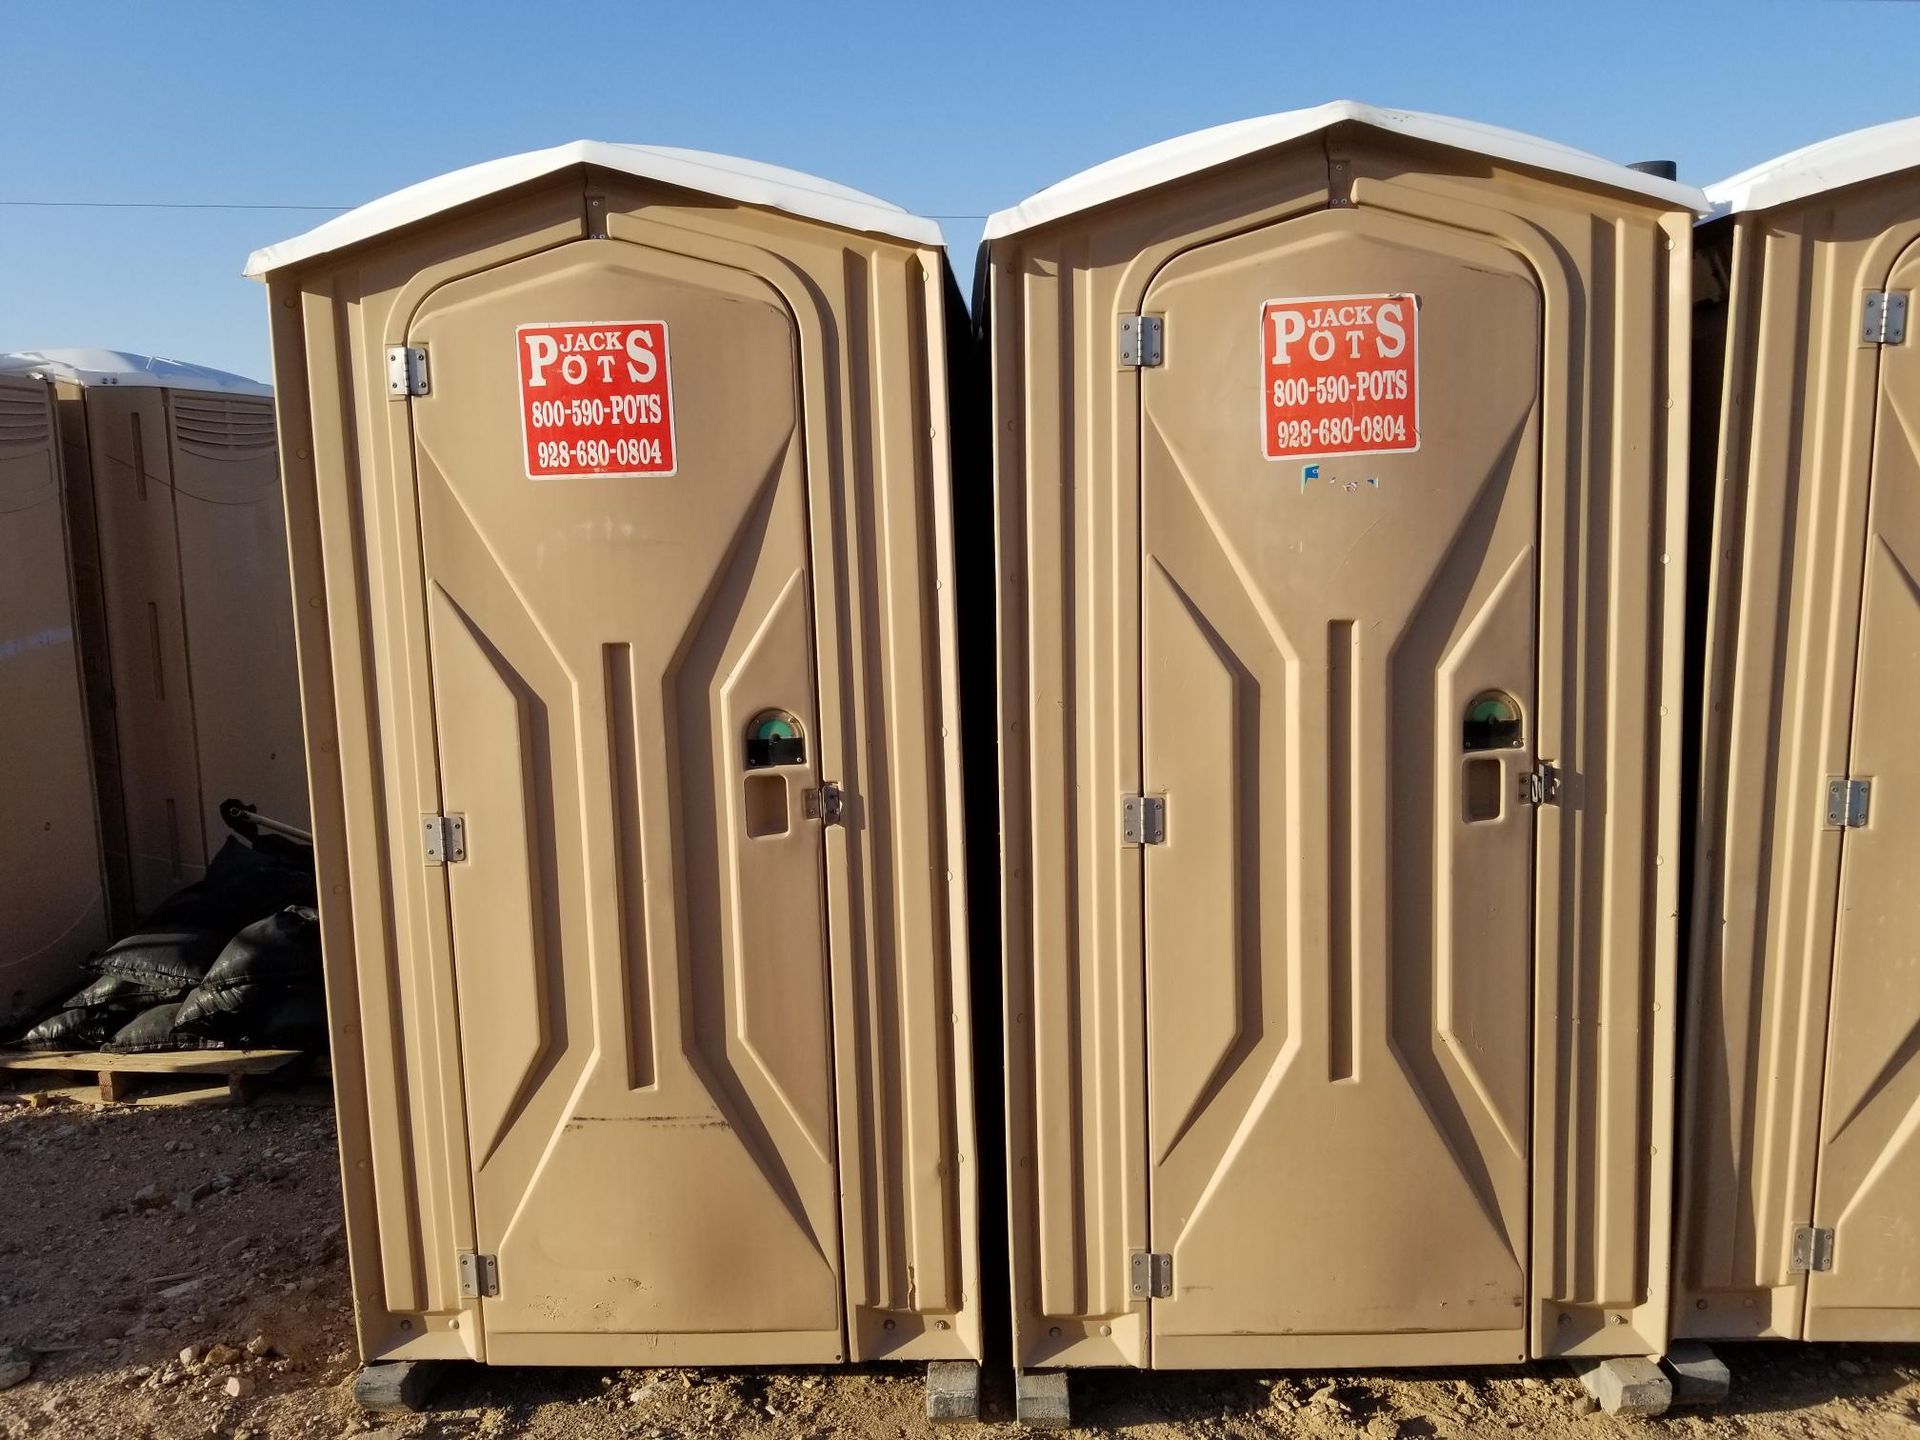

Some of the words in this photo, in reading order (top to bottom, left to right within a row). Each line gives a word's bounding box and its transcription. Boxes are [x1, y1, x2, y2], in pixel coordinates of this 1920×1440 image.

[1307, 305, 1374, 328] JACK
[559, 331, 624, 352] JACK
[1273, 369, 1408, 408] 800-590-POTS
[532, 394, 662, 428] 800-590-POTS
[1277, 415, 1406, 448] 928-680-0804
[538, 438, 662, 468] 928-680-0804
